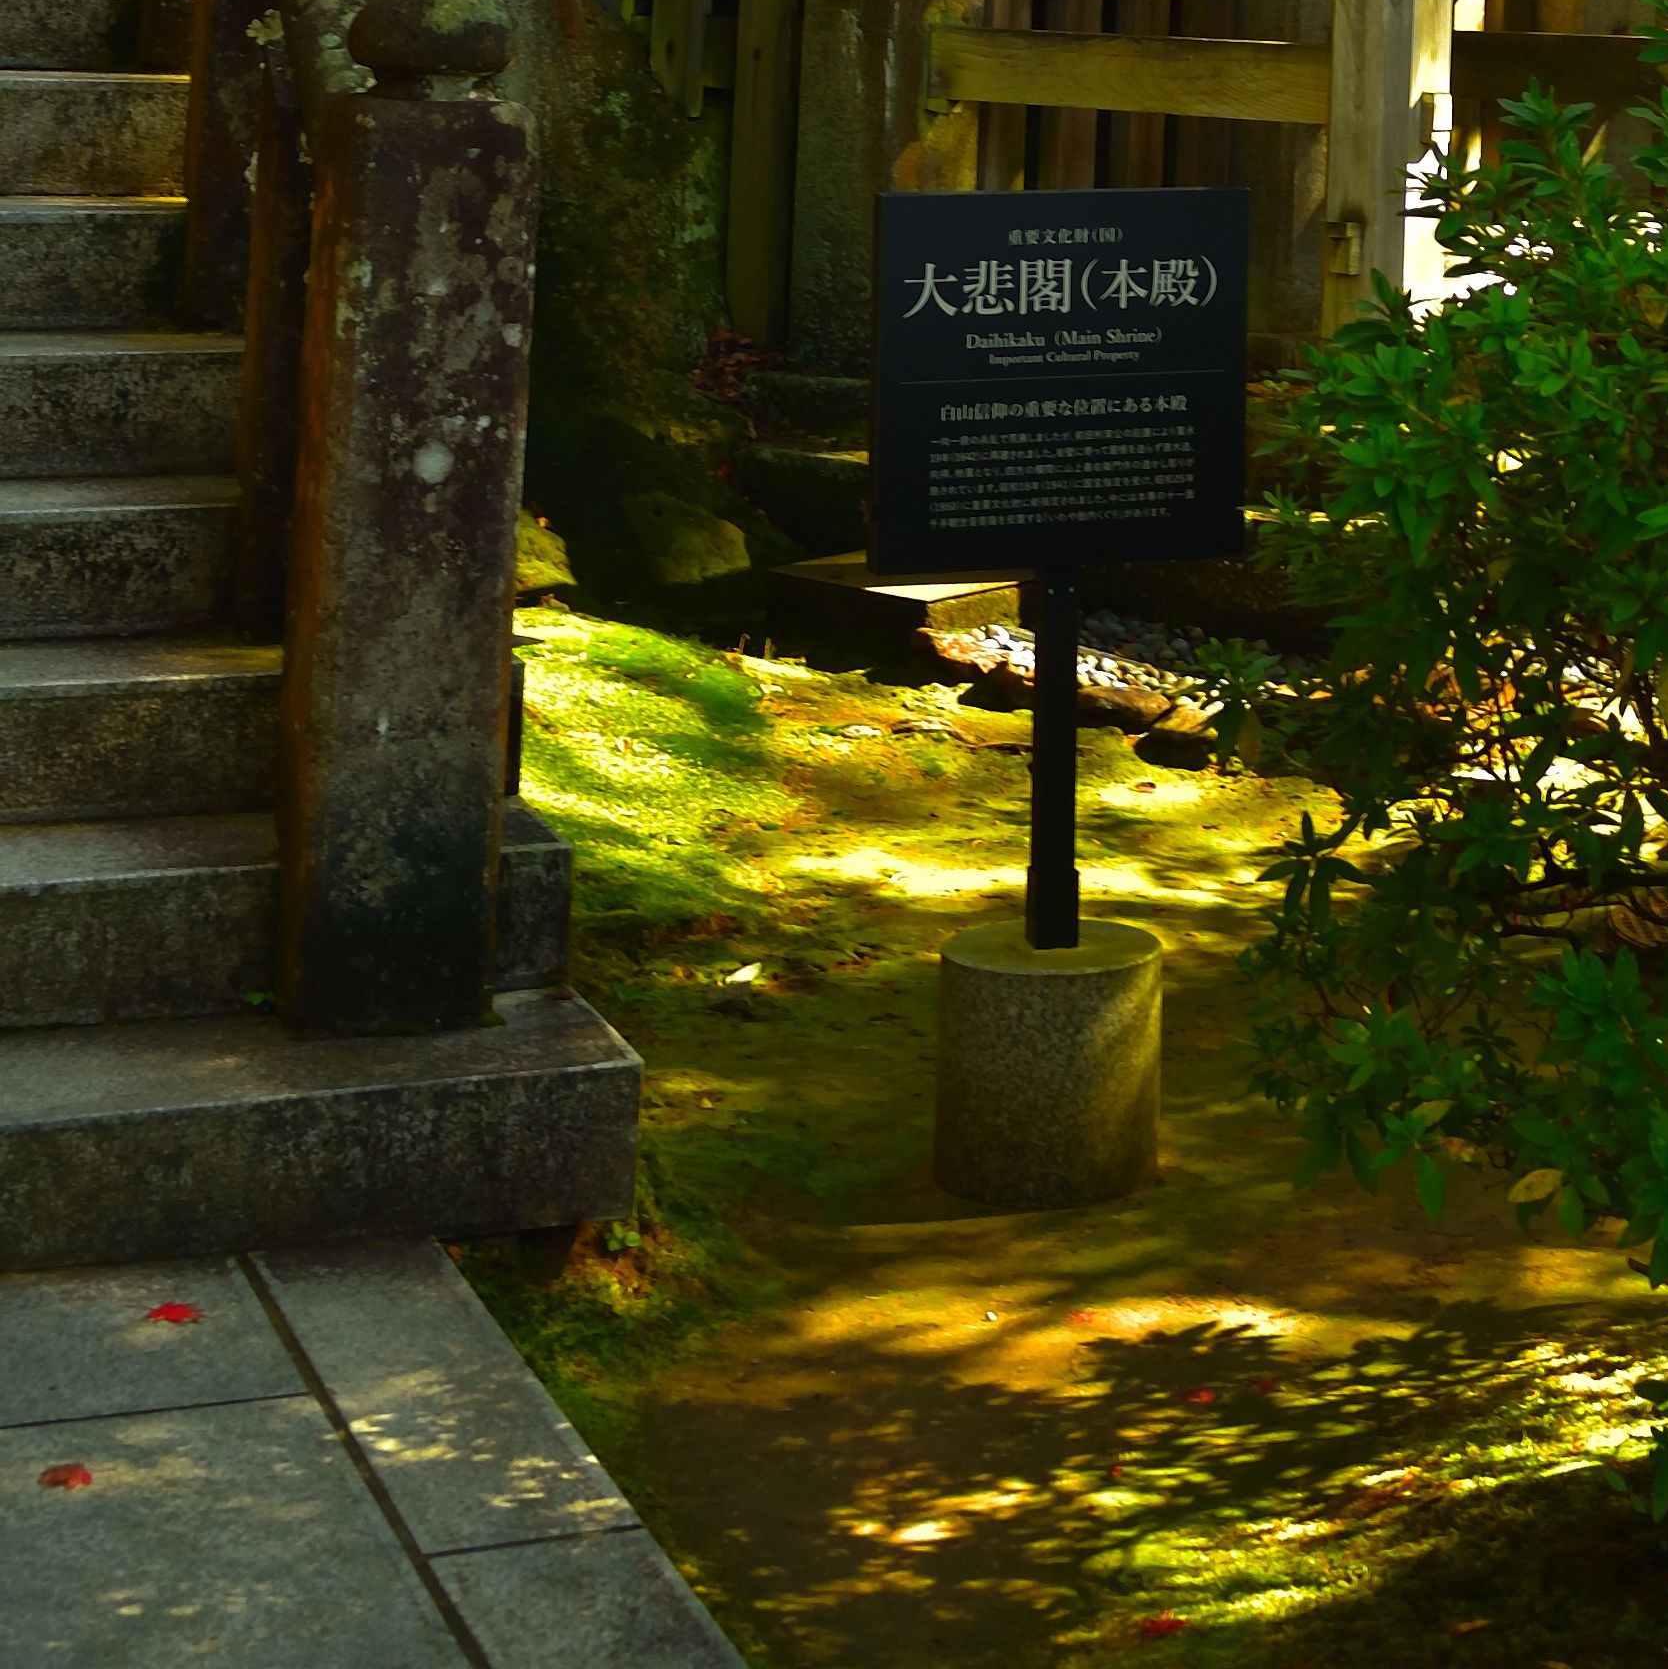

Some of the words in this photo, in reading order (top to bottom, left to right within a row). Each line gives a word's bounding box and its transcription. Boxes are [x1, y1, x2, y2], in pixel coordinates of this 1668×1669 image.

[901, 253, 1219, 319] 大悲閣(本殿)
[965, 331, 1046, 351] Daihikaku
[1053, 328, 1102, 348] (Main
[1105, 325, 1163, 346] Shrine)
